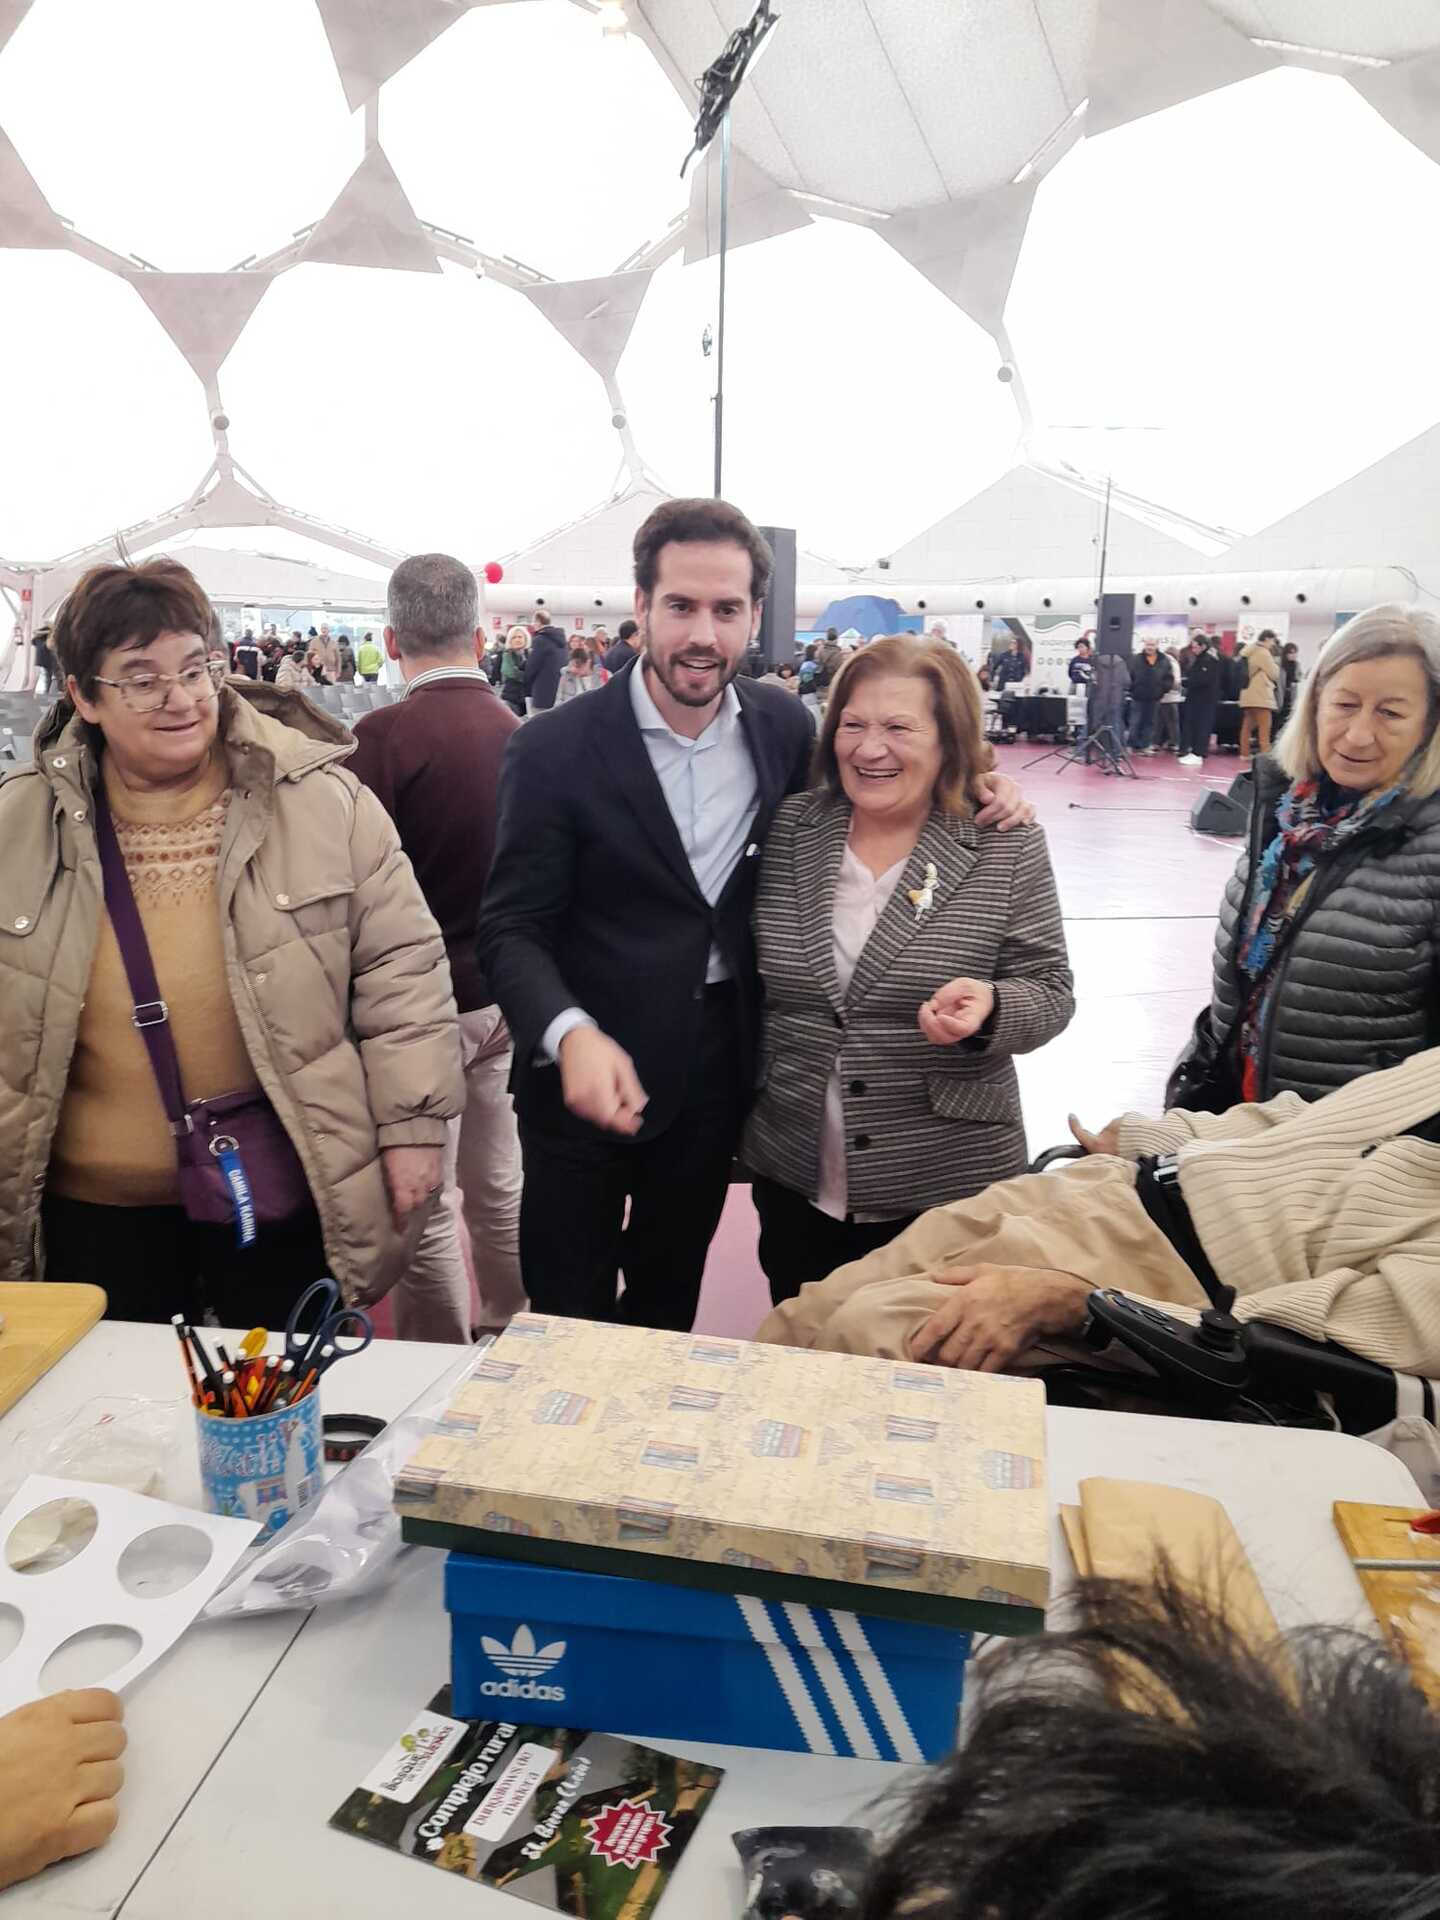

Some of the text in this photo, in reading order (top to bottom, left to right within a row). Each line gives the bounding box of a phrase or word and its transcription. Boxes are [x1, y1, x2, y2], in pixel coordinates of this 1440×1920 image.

[480, 1679, 566, 1701] adidas
[418, 1722, 517, 1837] Complejo rural
